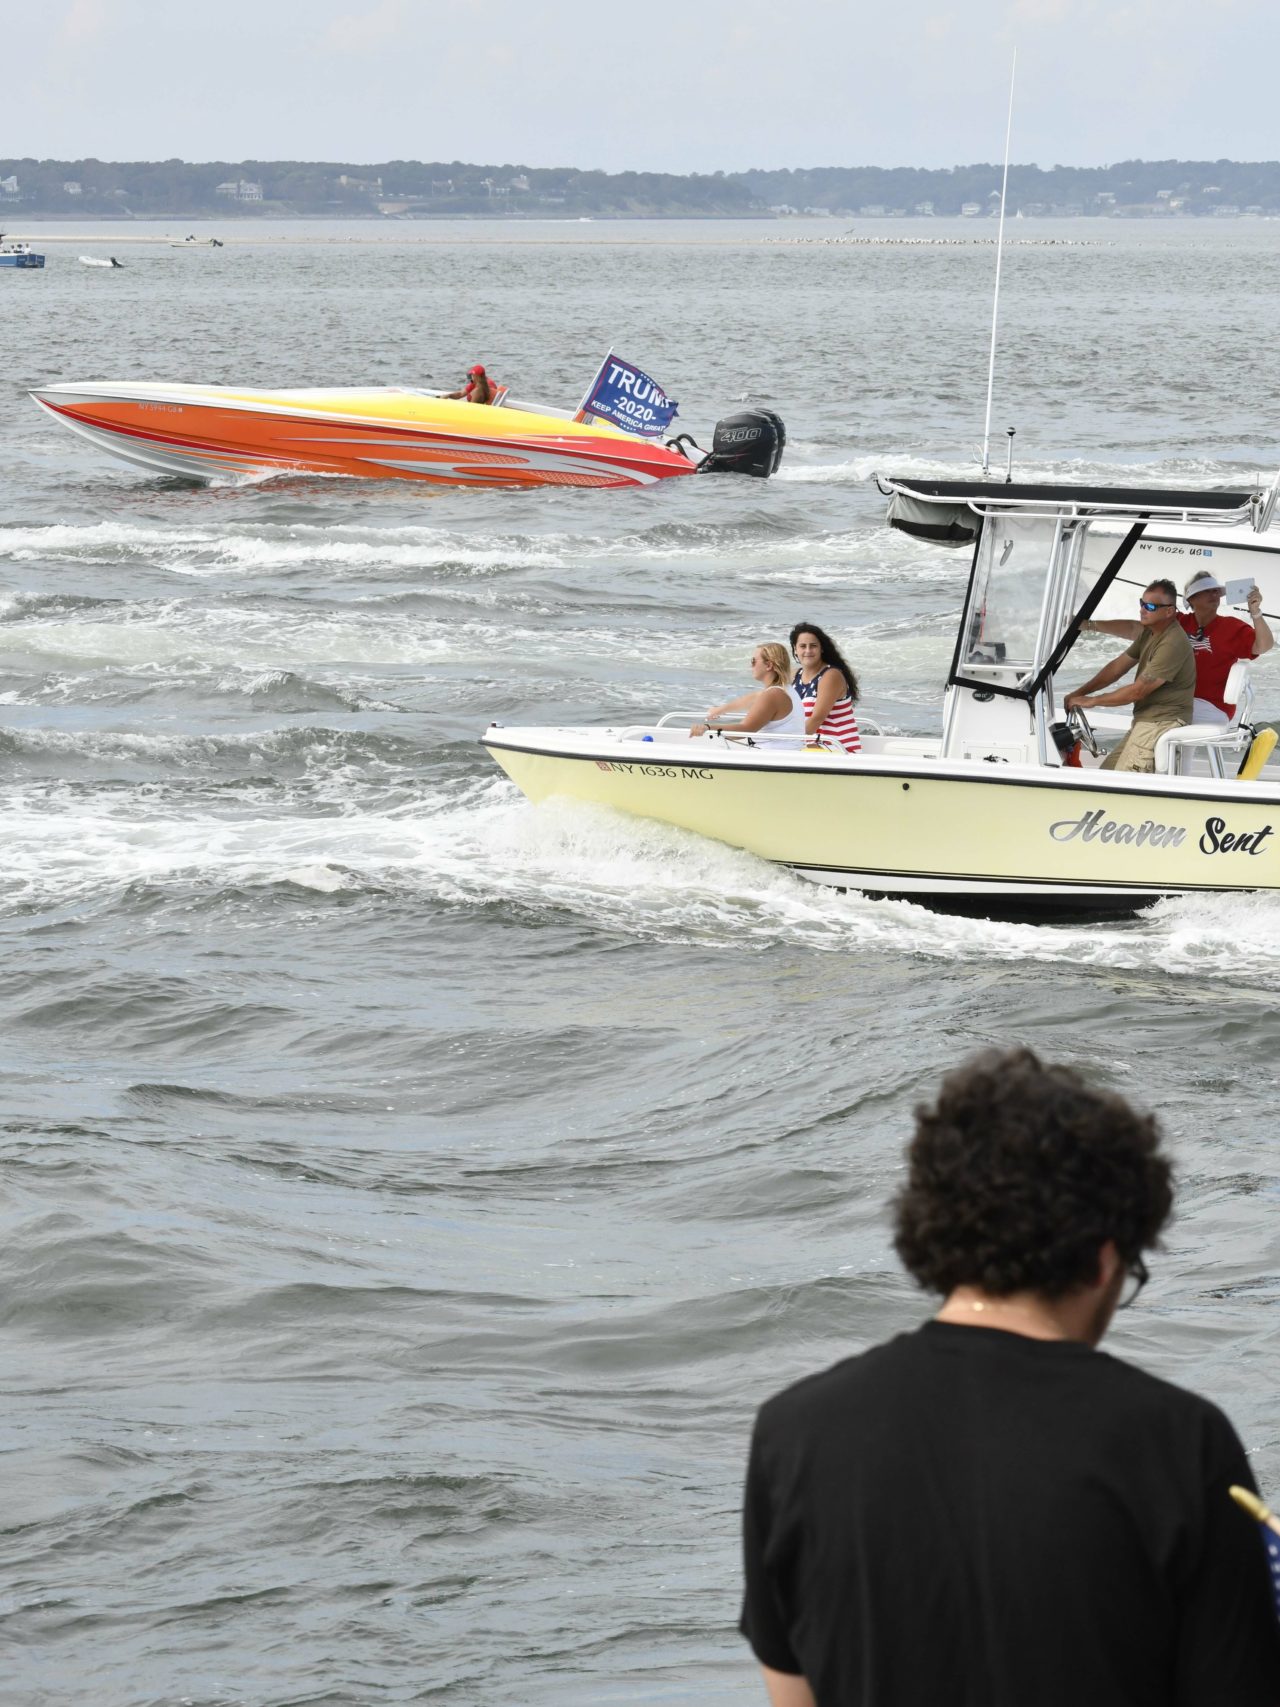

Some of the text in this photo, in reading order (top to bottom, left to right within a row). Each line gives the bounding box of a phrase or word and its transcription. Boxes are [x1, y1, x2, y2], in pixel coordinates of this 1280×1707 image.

[591, 400, 611, 412] KEEP
[611, 410, 643, 429] AMERICA
[720, 427, 762, 443] 400
[1157, 546, 1184, 554] 9026
[1189, 548, 1202, 556] US
[610, 762, 633, 774] NY
[640, 766, 677, 778] 1636
[682, 768, 714, 780] MG
[1049, 809, 1275, 856] Heaven Sent
